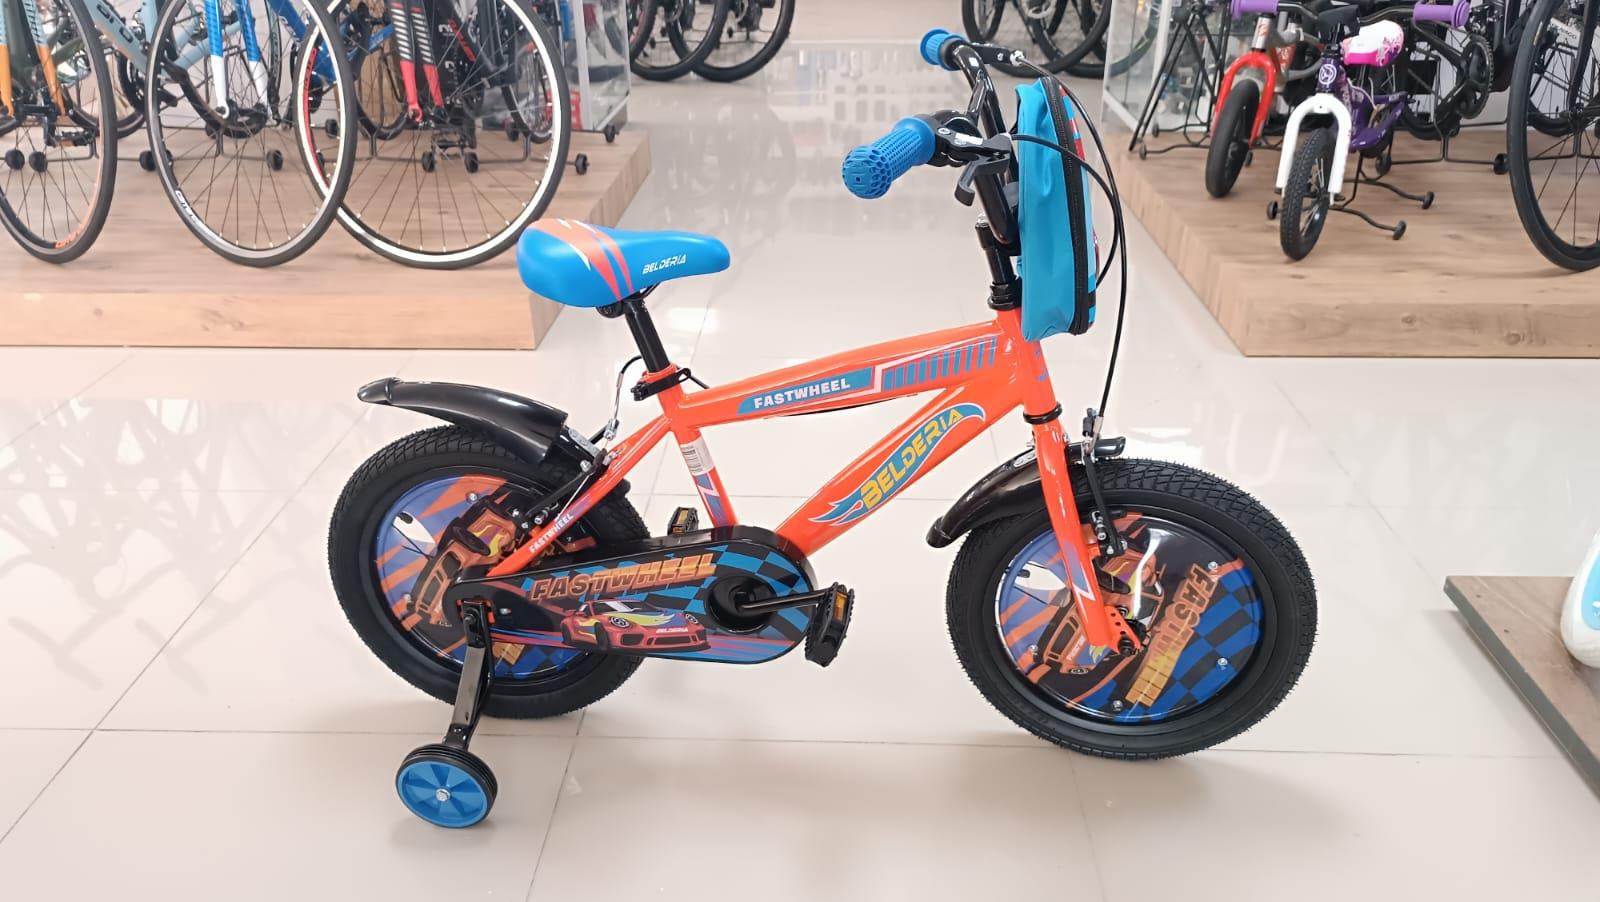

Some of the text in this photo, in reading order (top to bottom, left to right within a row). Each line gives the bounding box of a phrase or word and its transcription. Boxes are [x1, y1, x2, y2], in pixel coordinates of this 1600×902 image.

[643, 254, 687, 274] BELDERIA
[753, 378, 851, 408] FASTWHEEL
[529, 514, 574, 553] FASTWHEEL
[530, 552, 717, 600] FASTWHEEL
